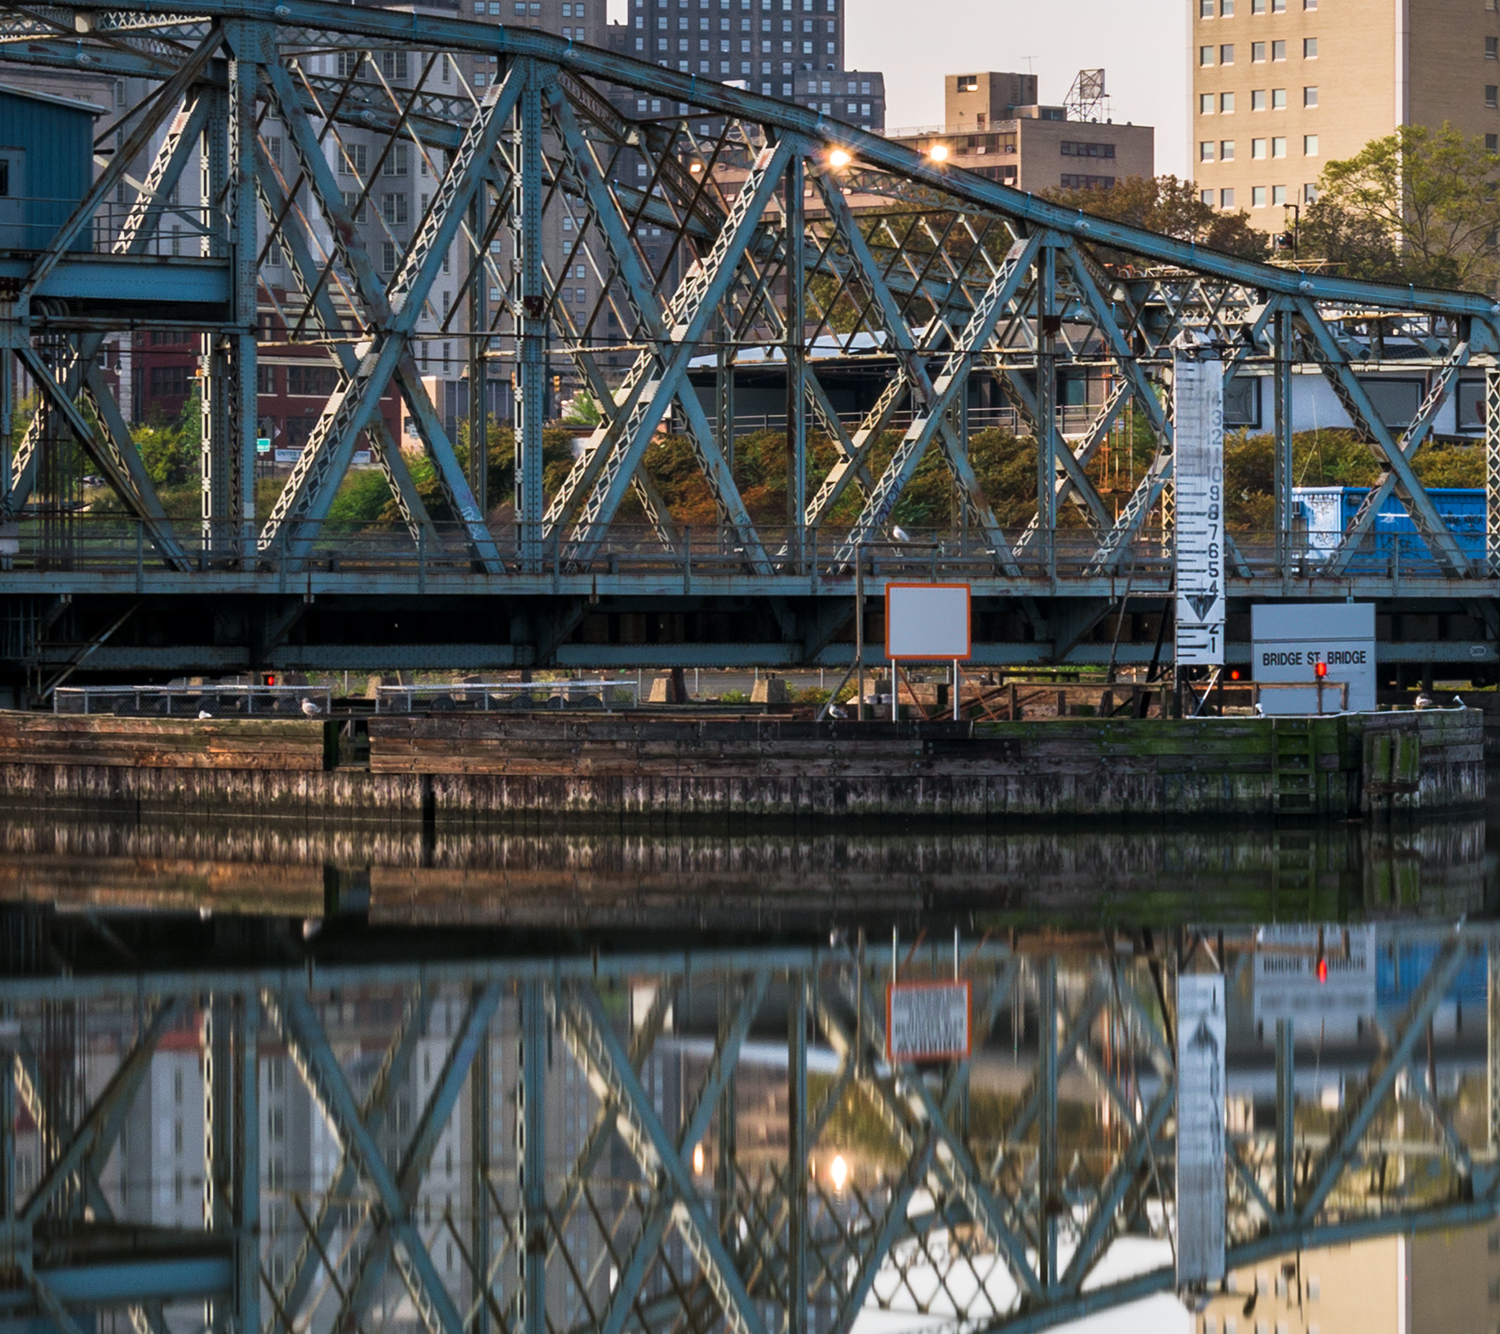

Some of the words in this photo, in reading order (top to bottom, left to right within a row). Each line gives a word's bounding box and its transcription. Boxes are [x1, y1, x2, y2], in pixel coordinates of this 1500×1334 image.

[1207, 429, 1222, 445] 12
[1207, 466, 1222, 483] 10
[1209, 485, 1220, 501] 9
[1208, 503, 1219, 521] 8
[1208, 524, 1219, 541] 7
[1208, 542, 1219, 559] 6
[1208, 561, 1219, 578] 5
[1208, 580, 1219, 596] 4
[1210, 637, 1216, 654] 1
[1263, 652, 1302, 666] BRIDGE
[1307, 651, 1321, 665] ST
[1327, 650, 1366, 665] BRIDGE
